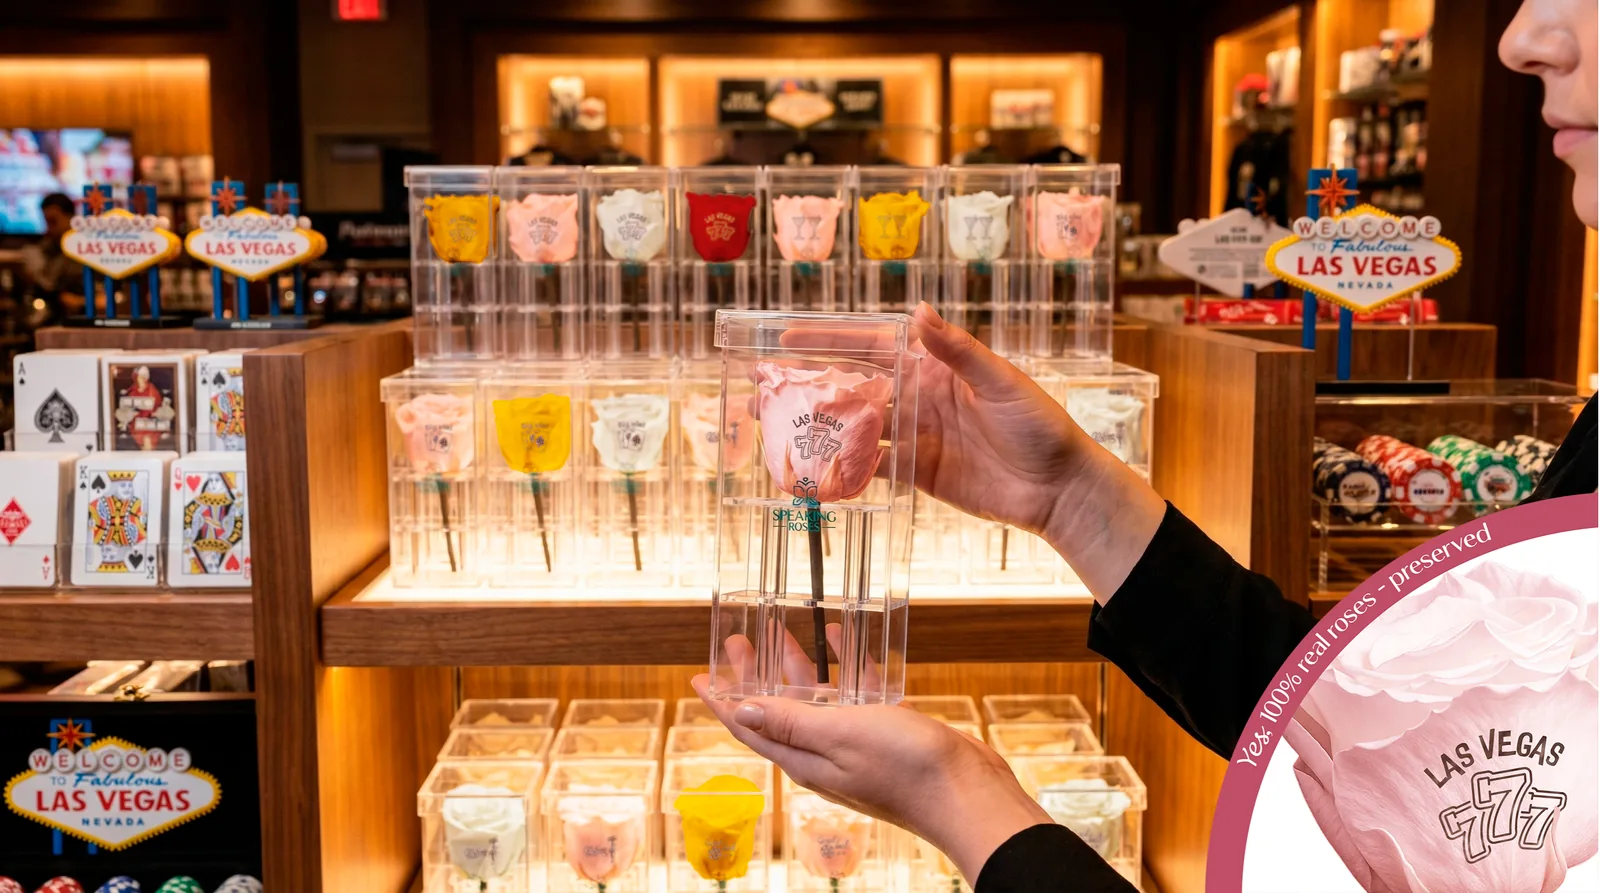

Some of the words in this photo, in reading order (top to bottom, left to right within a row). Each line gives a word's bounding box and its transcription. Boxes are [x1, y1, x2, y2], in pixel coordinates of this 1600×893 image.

[1298, 221, 1436, 236] WELCOME
[77, 241, 103, 255] LAS
[108, 241, 157, 255] VEGAS
[205, 242, 235, 256] LAS
[241, 242, 297, 256] VEGAS
[1311, 242, 1326, 251] TO
[1330, 239, 1413, 253] Fabulous
[1297, 256, 1343, 276] LAS
[1352, 256, 1437, 276] VEGAS
[1337, 281, 1393, 289] NEVADA
[18, 361, 26, 375] A
[792, 414, 811, 428] LAS
[813, 412, 844, 432] VEGAS
[794, 426, 842, 462] 777
[80, 465, 88, 479] K
[772, 510, 837, 523] SPEAKING
[788, 522, 820, 532] ROSES
[32, 753, 185, 769] WELCOME
[1424, 742, 1475, 789] LAS
[1478, 728, 1565, 767] VEGAS
[51, 775, 67, 786] TO
[73, 772, 168, 788] Fabulous
[36, 790, 87, 812] LAS
[97, 790, 191, 812] VEGAS
[82, 818, 145, 826] NEVADA
[1439, 766, 1568, 864] 777
